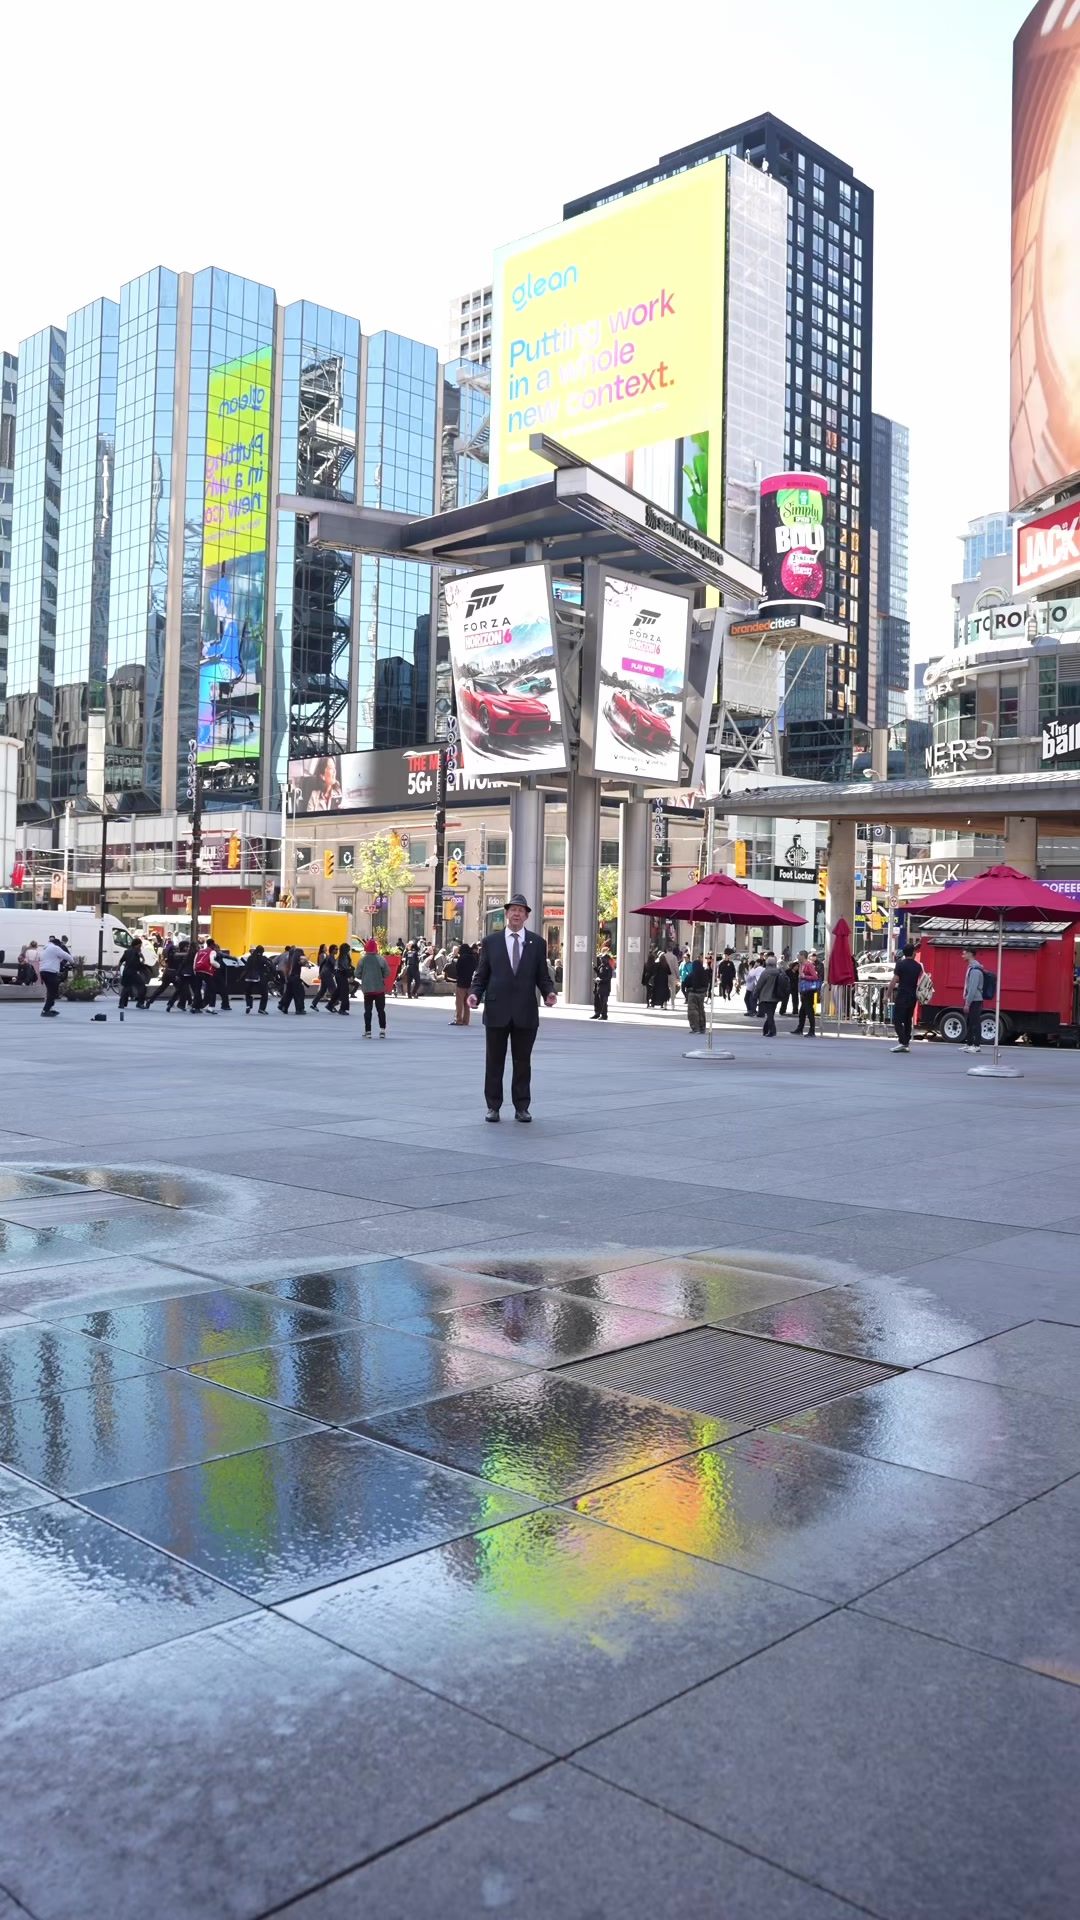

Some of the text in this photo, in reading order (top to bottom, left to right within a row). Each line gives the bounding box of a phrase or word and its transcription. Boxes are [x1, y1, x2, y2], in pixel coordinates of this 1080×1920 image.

[512, 265, 577, 312] glean
[510, 288, 676, 368] Putting work
[509, 339, 635, 400] in a whole
[508, 400, 559, 433] new
[566, 361, 675, 416] context.
[783, 502, 819, 522] Simply
[657, 517, 724, 566] sankofa square
[775, 523, 825, 554] BOLD
[1020, 516, 1080, 577] JACK
[463, 617, 511, 632] FORZA
[731, 617, 797, 635] brandedcities
[974, 605, 1067, 633] TOROO
[464, 629, 512, 650] HORIZON 6
[629, 629, 661, 642] FORZA
[656, 645, 660, 654] 6
[1047, 720, 1068, 737] The
[409, 755, 427, 771] THE
[408, 772, 433, 795] 5G+
[779, 869, 815, 881] Foot Locker
